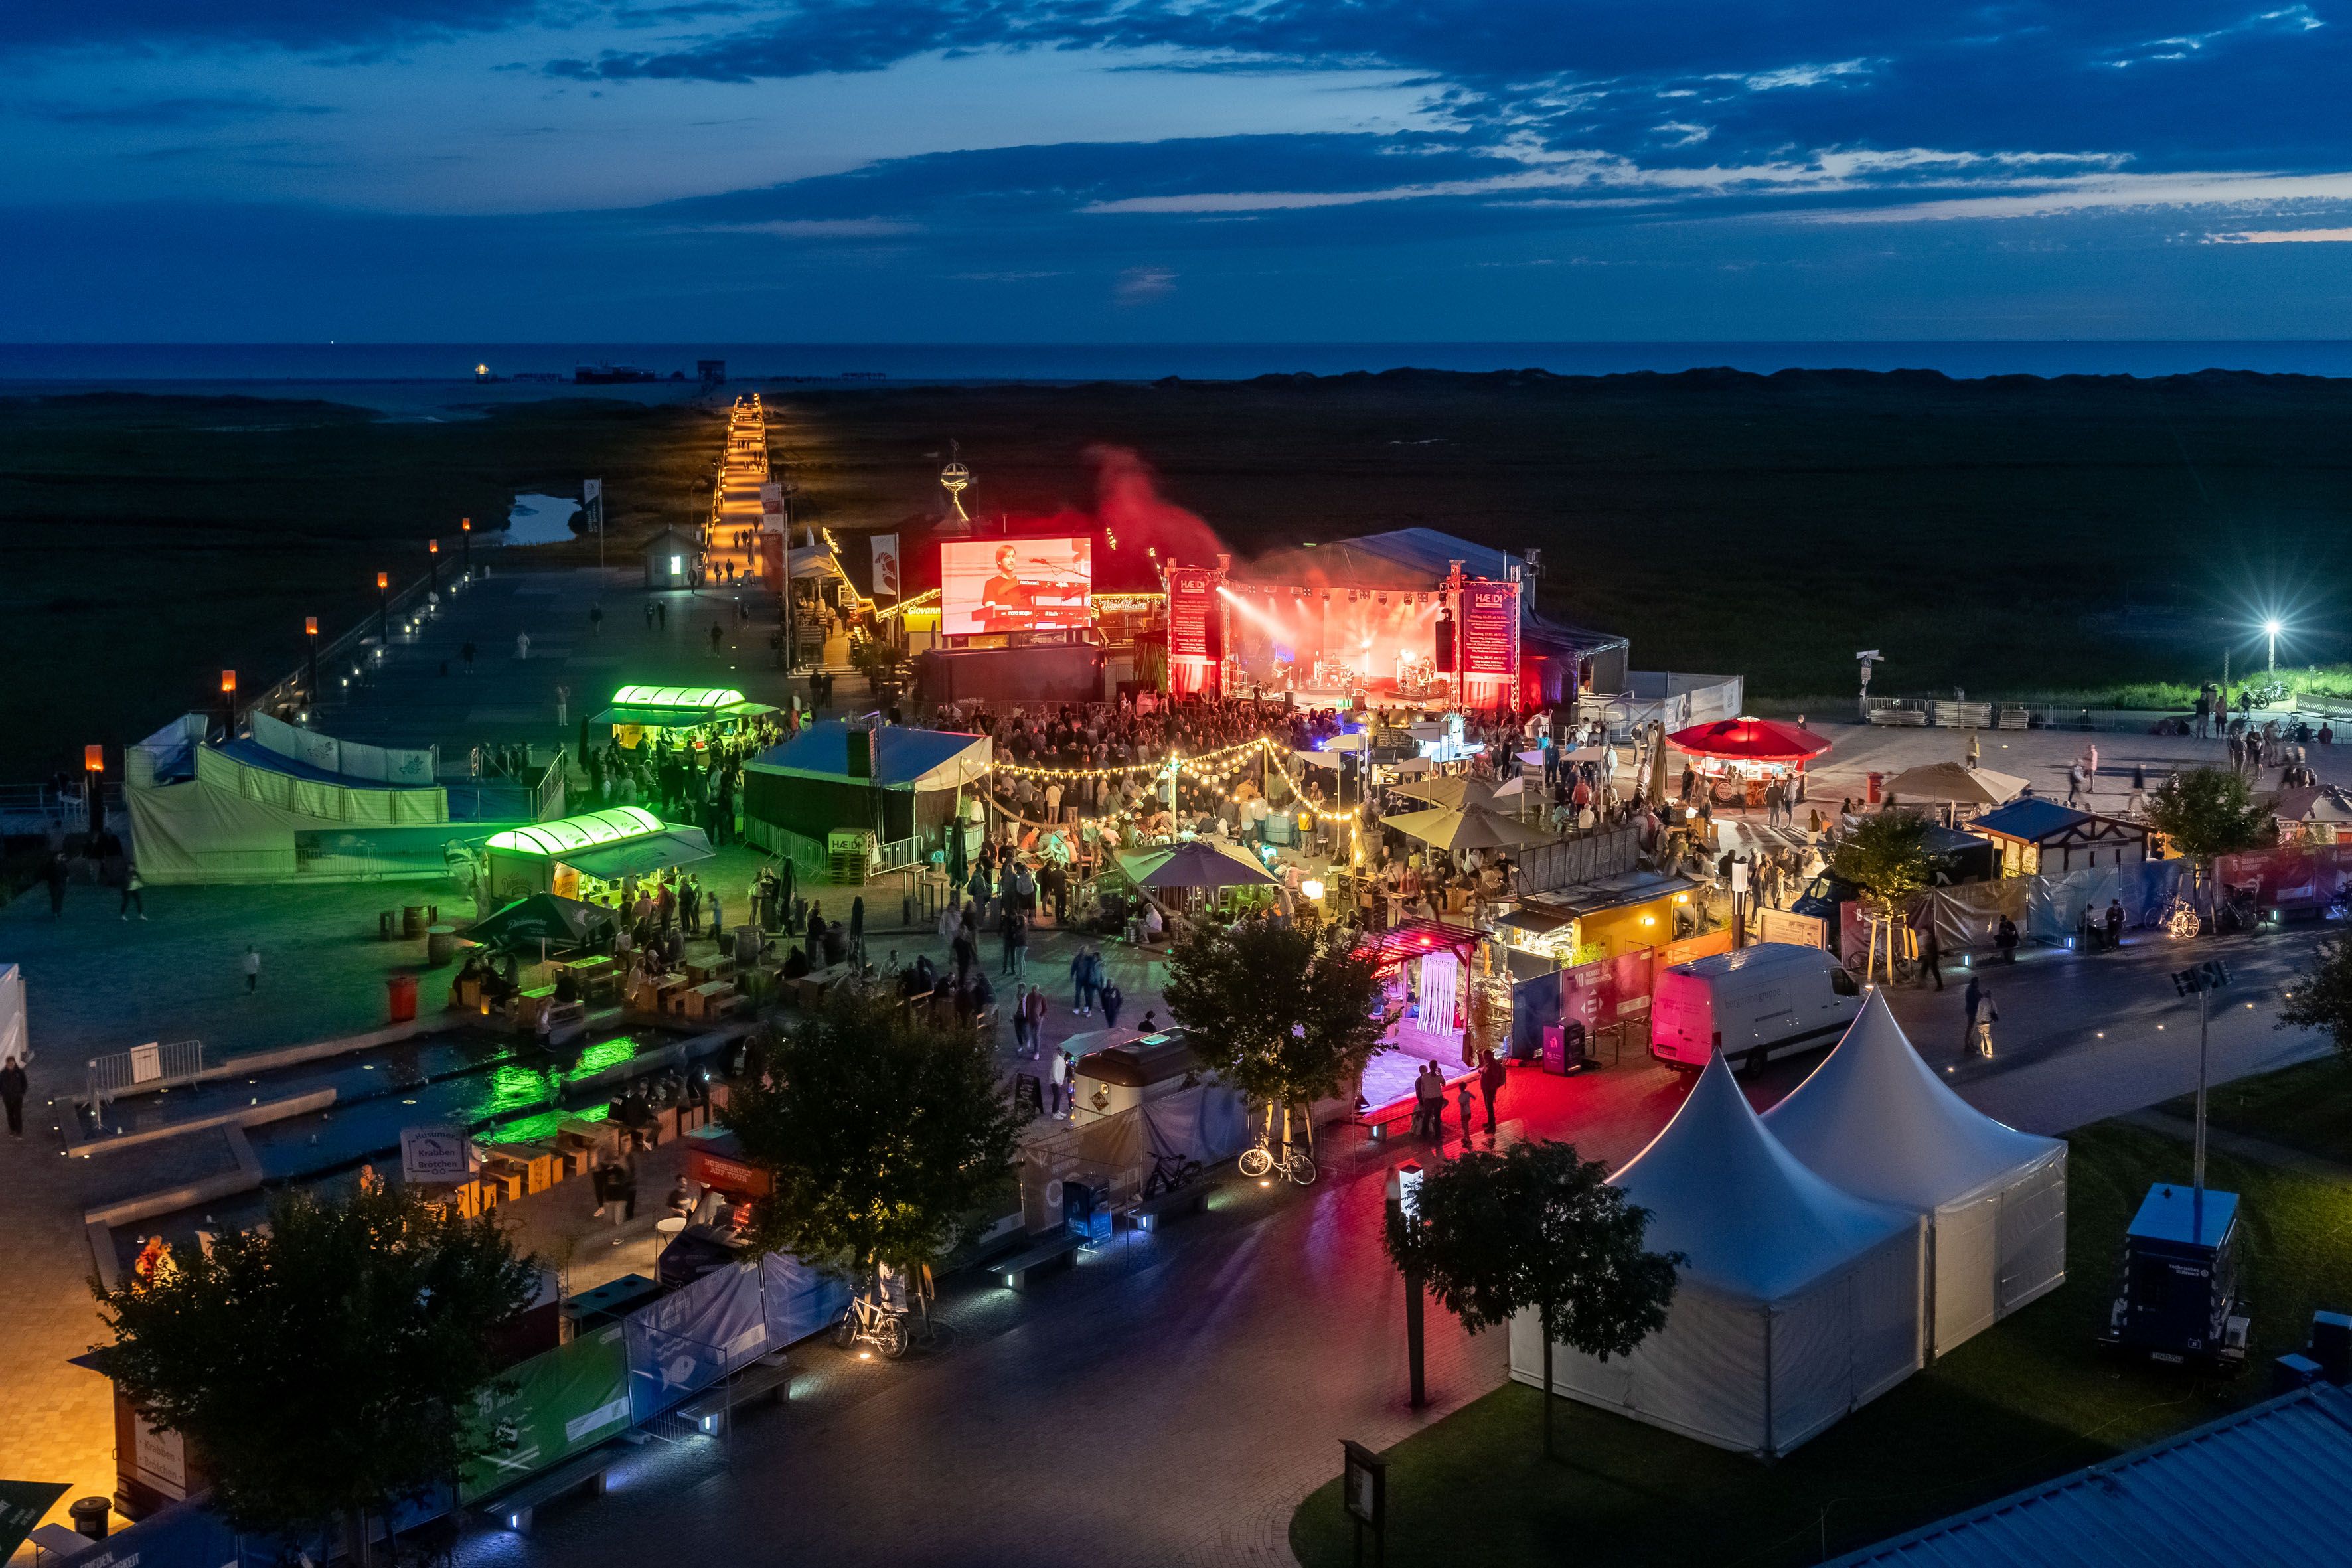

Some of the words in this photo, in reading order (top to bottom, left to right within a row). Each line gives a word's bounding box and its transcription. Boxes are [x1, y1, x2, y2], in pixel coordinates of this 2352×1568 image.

[2233, 860, 2238, 872] 5
[1668, 950, 1673, 964] 9
[1575, 973, 1584, 988] 10
[415, 1131, 456, 1140] Husumer
[704, 1158, 753, 1177] BURGERKULT
[710, 1167, 725, 1176] AUF
[727, 1171, 747, 1182] TOUR
